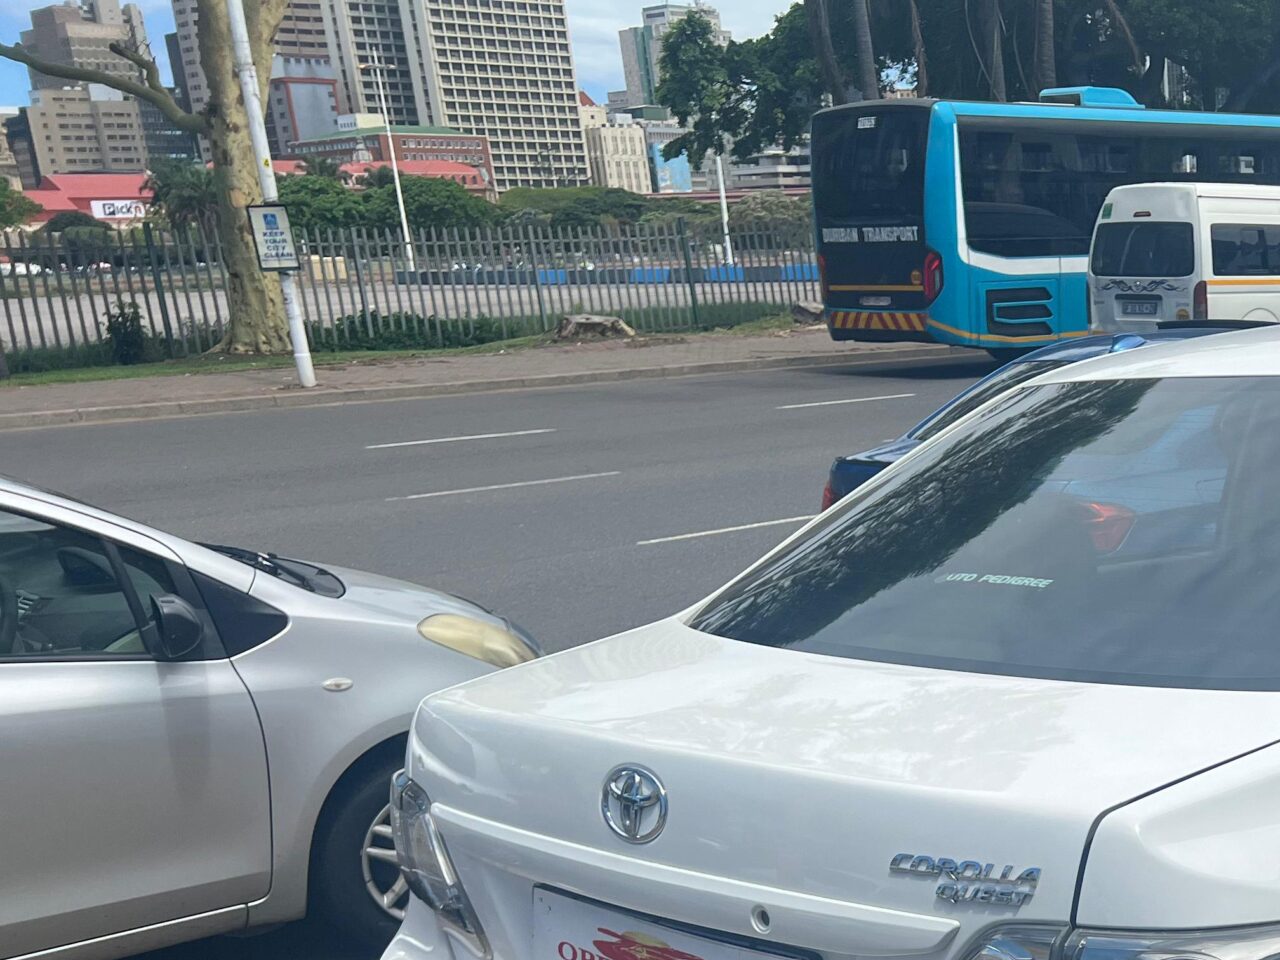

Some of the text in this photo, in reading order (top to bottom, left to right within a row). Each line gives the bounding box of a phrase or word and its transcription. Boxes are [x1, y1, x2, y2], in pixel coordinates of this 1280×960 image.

[102, 203, 133, 216] Pick
[822, 226, 918, 242] DURBAN TRANSPORT
[266, 244, 286, 252] CITY
[939, 572, 1054, 588] UTO PEDIGREE
[889, 853, 1042, 884] COROLLA
[936, 882, 1034, 905] QUEST
